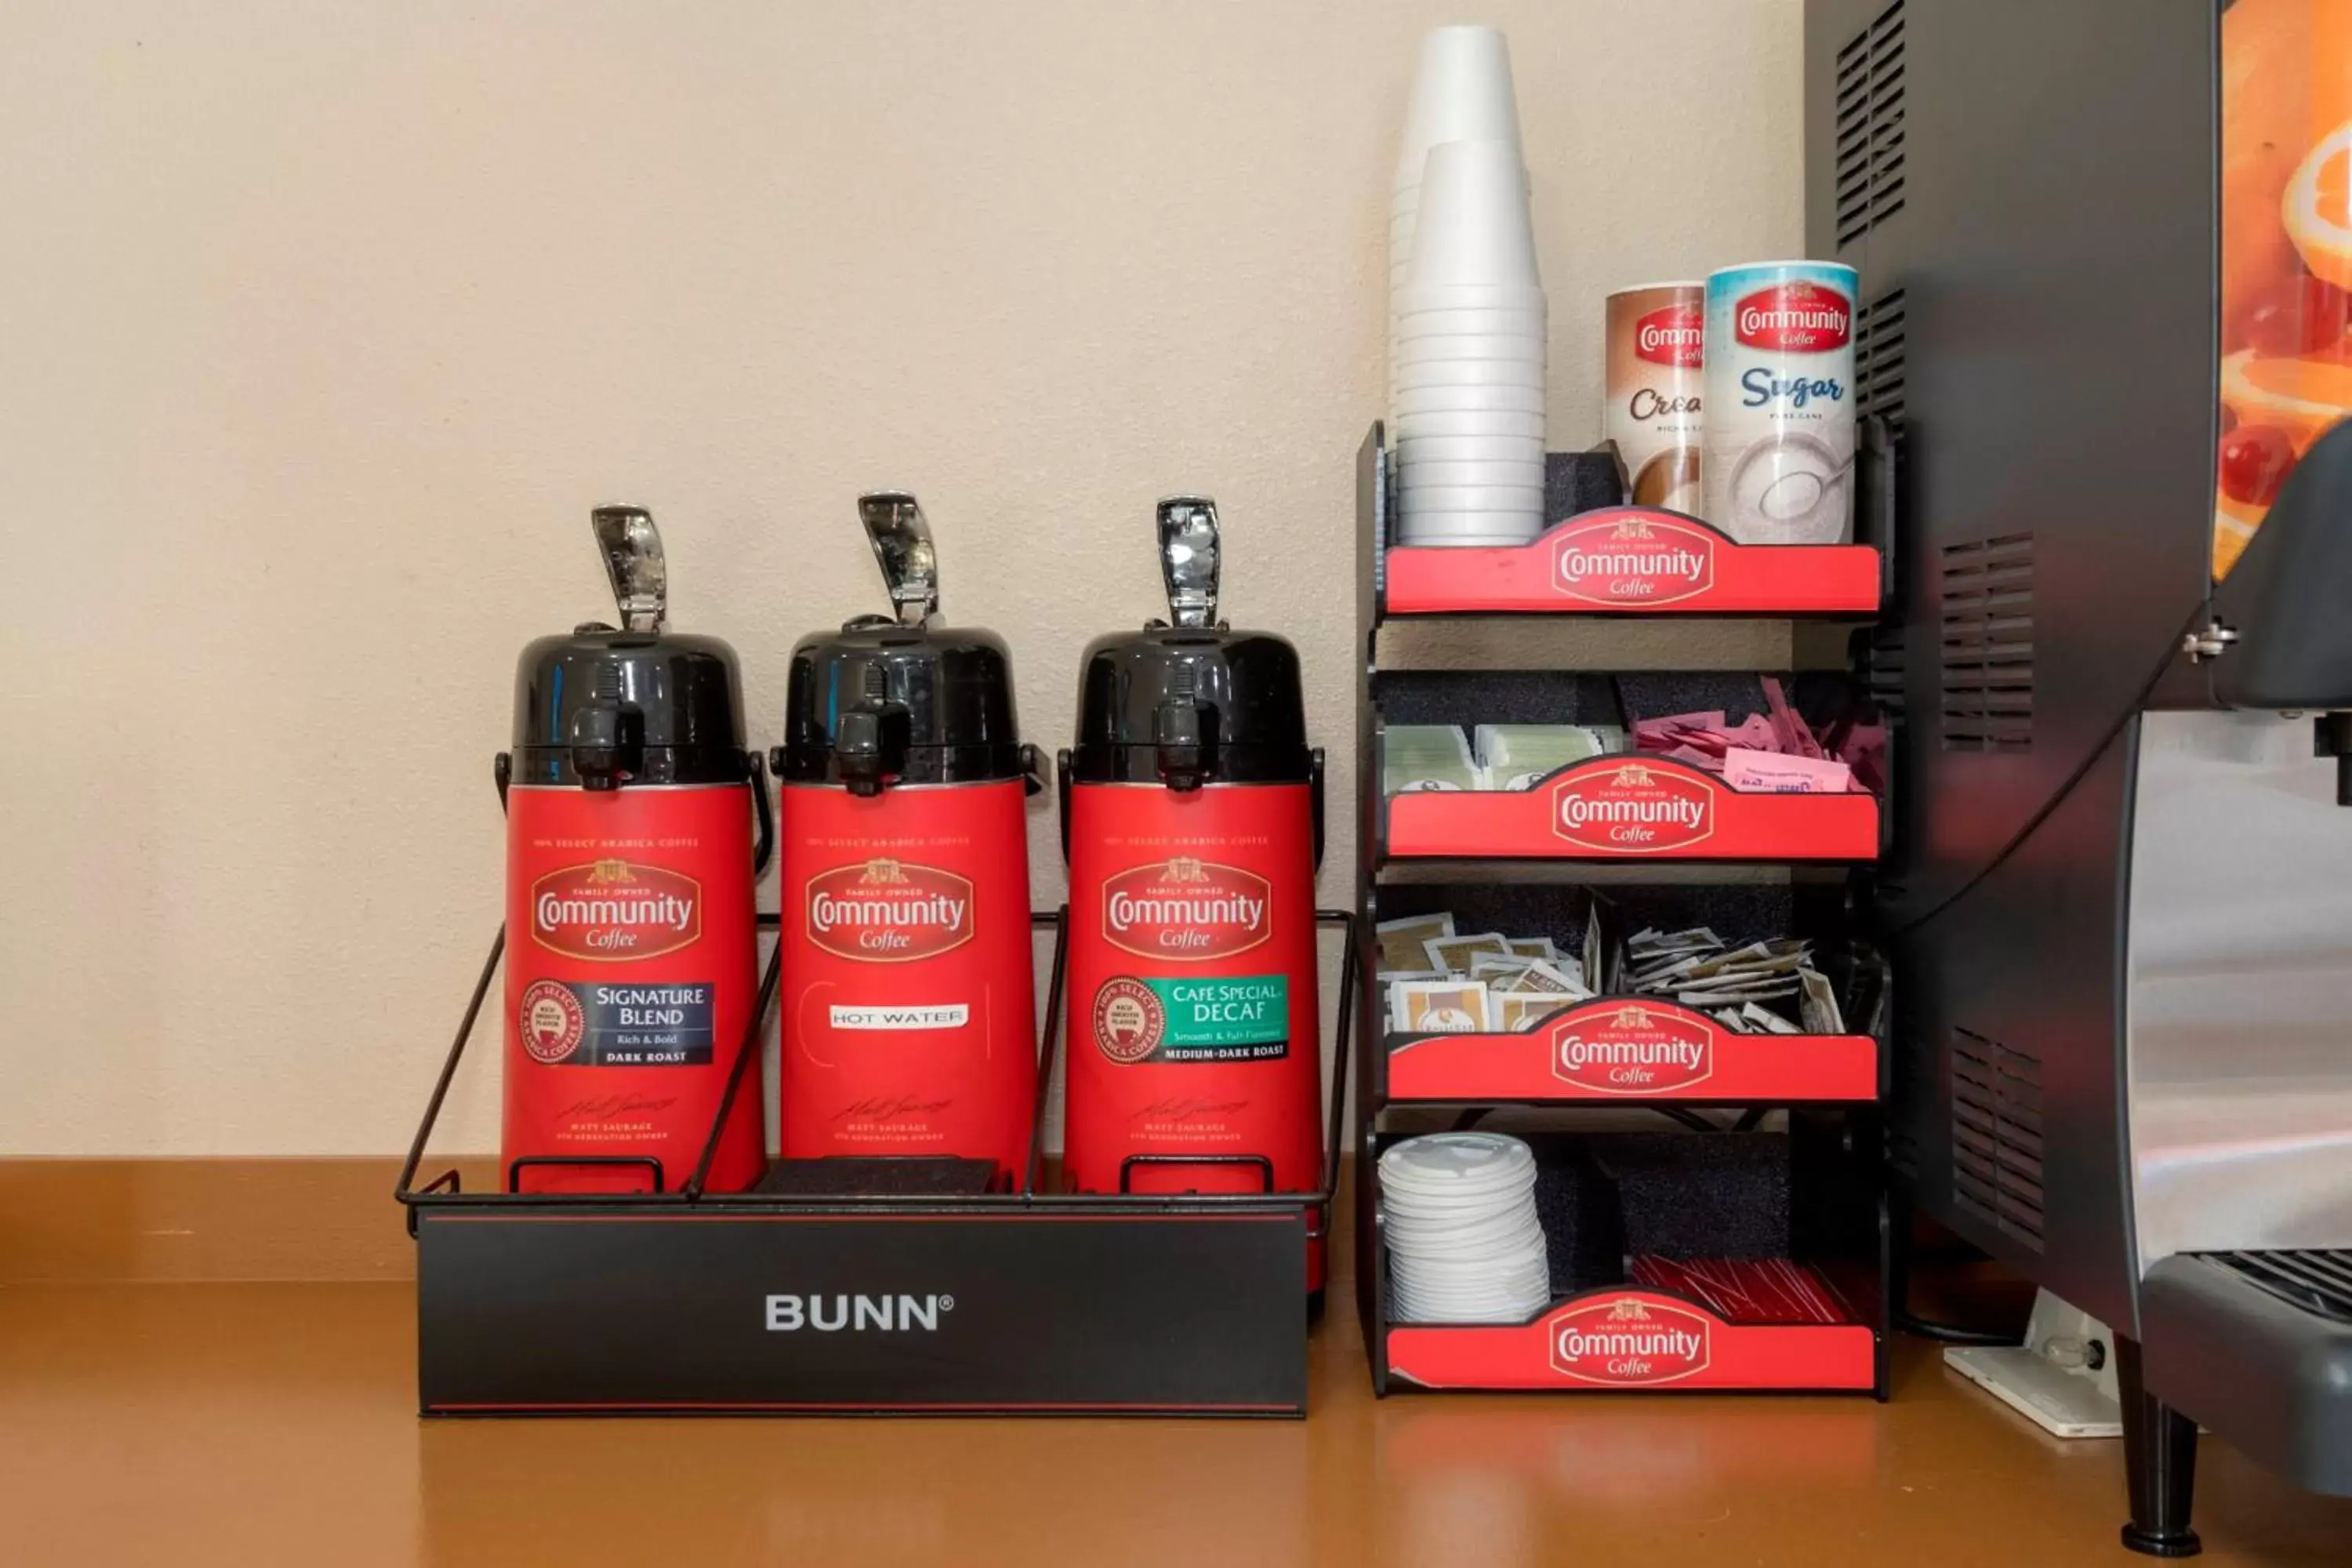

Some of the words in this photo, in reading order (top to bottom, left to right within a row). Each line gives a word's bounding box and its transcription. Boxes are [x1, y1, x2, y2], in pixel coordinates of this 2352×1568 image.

[1741, 307, 1847, 336] Community
[1640, 324, 1704, 351] Comm
[1741, 367, 1844, 408] Sugar
[1560, 546, 1704, 583] Community
[1610, 578, 1655, 597] Coffee
[1562, 793, 1704, 829] Community
[1610, 826, 1655, 843] Coffee
[538, 892, 693, 932] Community
[813, 892, 965, 932] Community
[1109, 891, 1263, 931] Community
[586, 927, 638, 951] Coffee
[859, 928, 910, 951] Coffee
[1159, 927, 1210, 949] Coffee
[596, 987, 705, 1005] SIGNATURE
[619, 1008, 684, 1025] BLEND
[833, 1014, 875, 1024] HOT
[884, 1011, 964, 1024] WATER
[1194, 1002, 1265, 1022] DECAF
[617, 1034, 641, 1045] Rich
[643, 1035, 652, 1044] &
[654, 1034, 677, 1044] Bold
[1254, 1045, 1284, 1056] ROAST
[606, 1053, 642, 1062] DARK
[646, 1051, 687, 1062] ROAST
[1561, 1036, 1704, 1071] Community
[1610, 1066, 1655, 1085] Coffee
[1558, 1327, 1701, 1363] Community
[1606, 1356, 1652, 1377] Coffee
